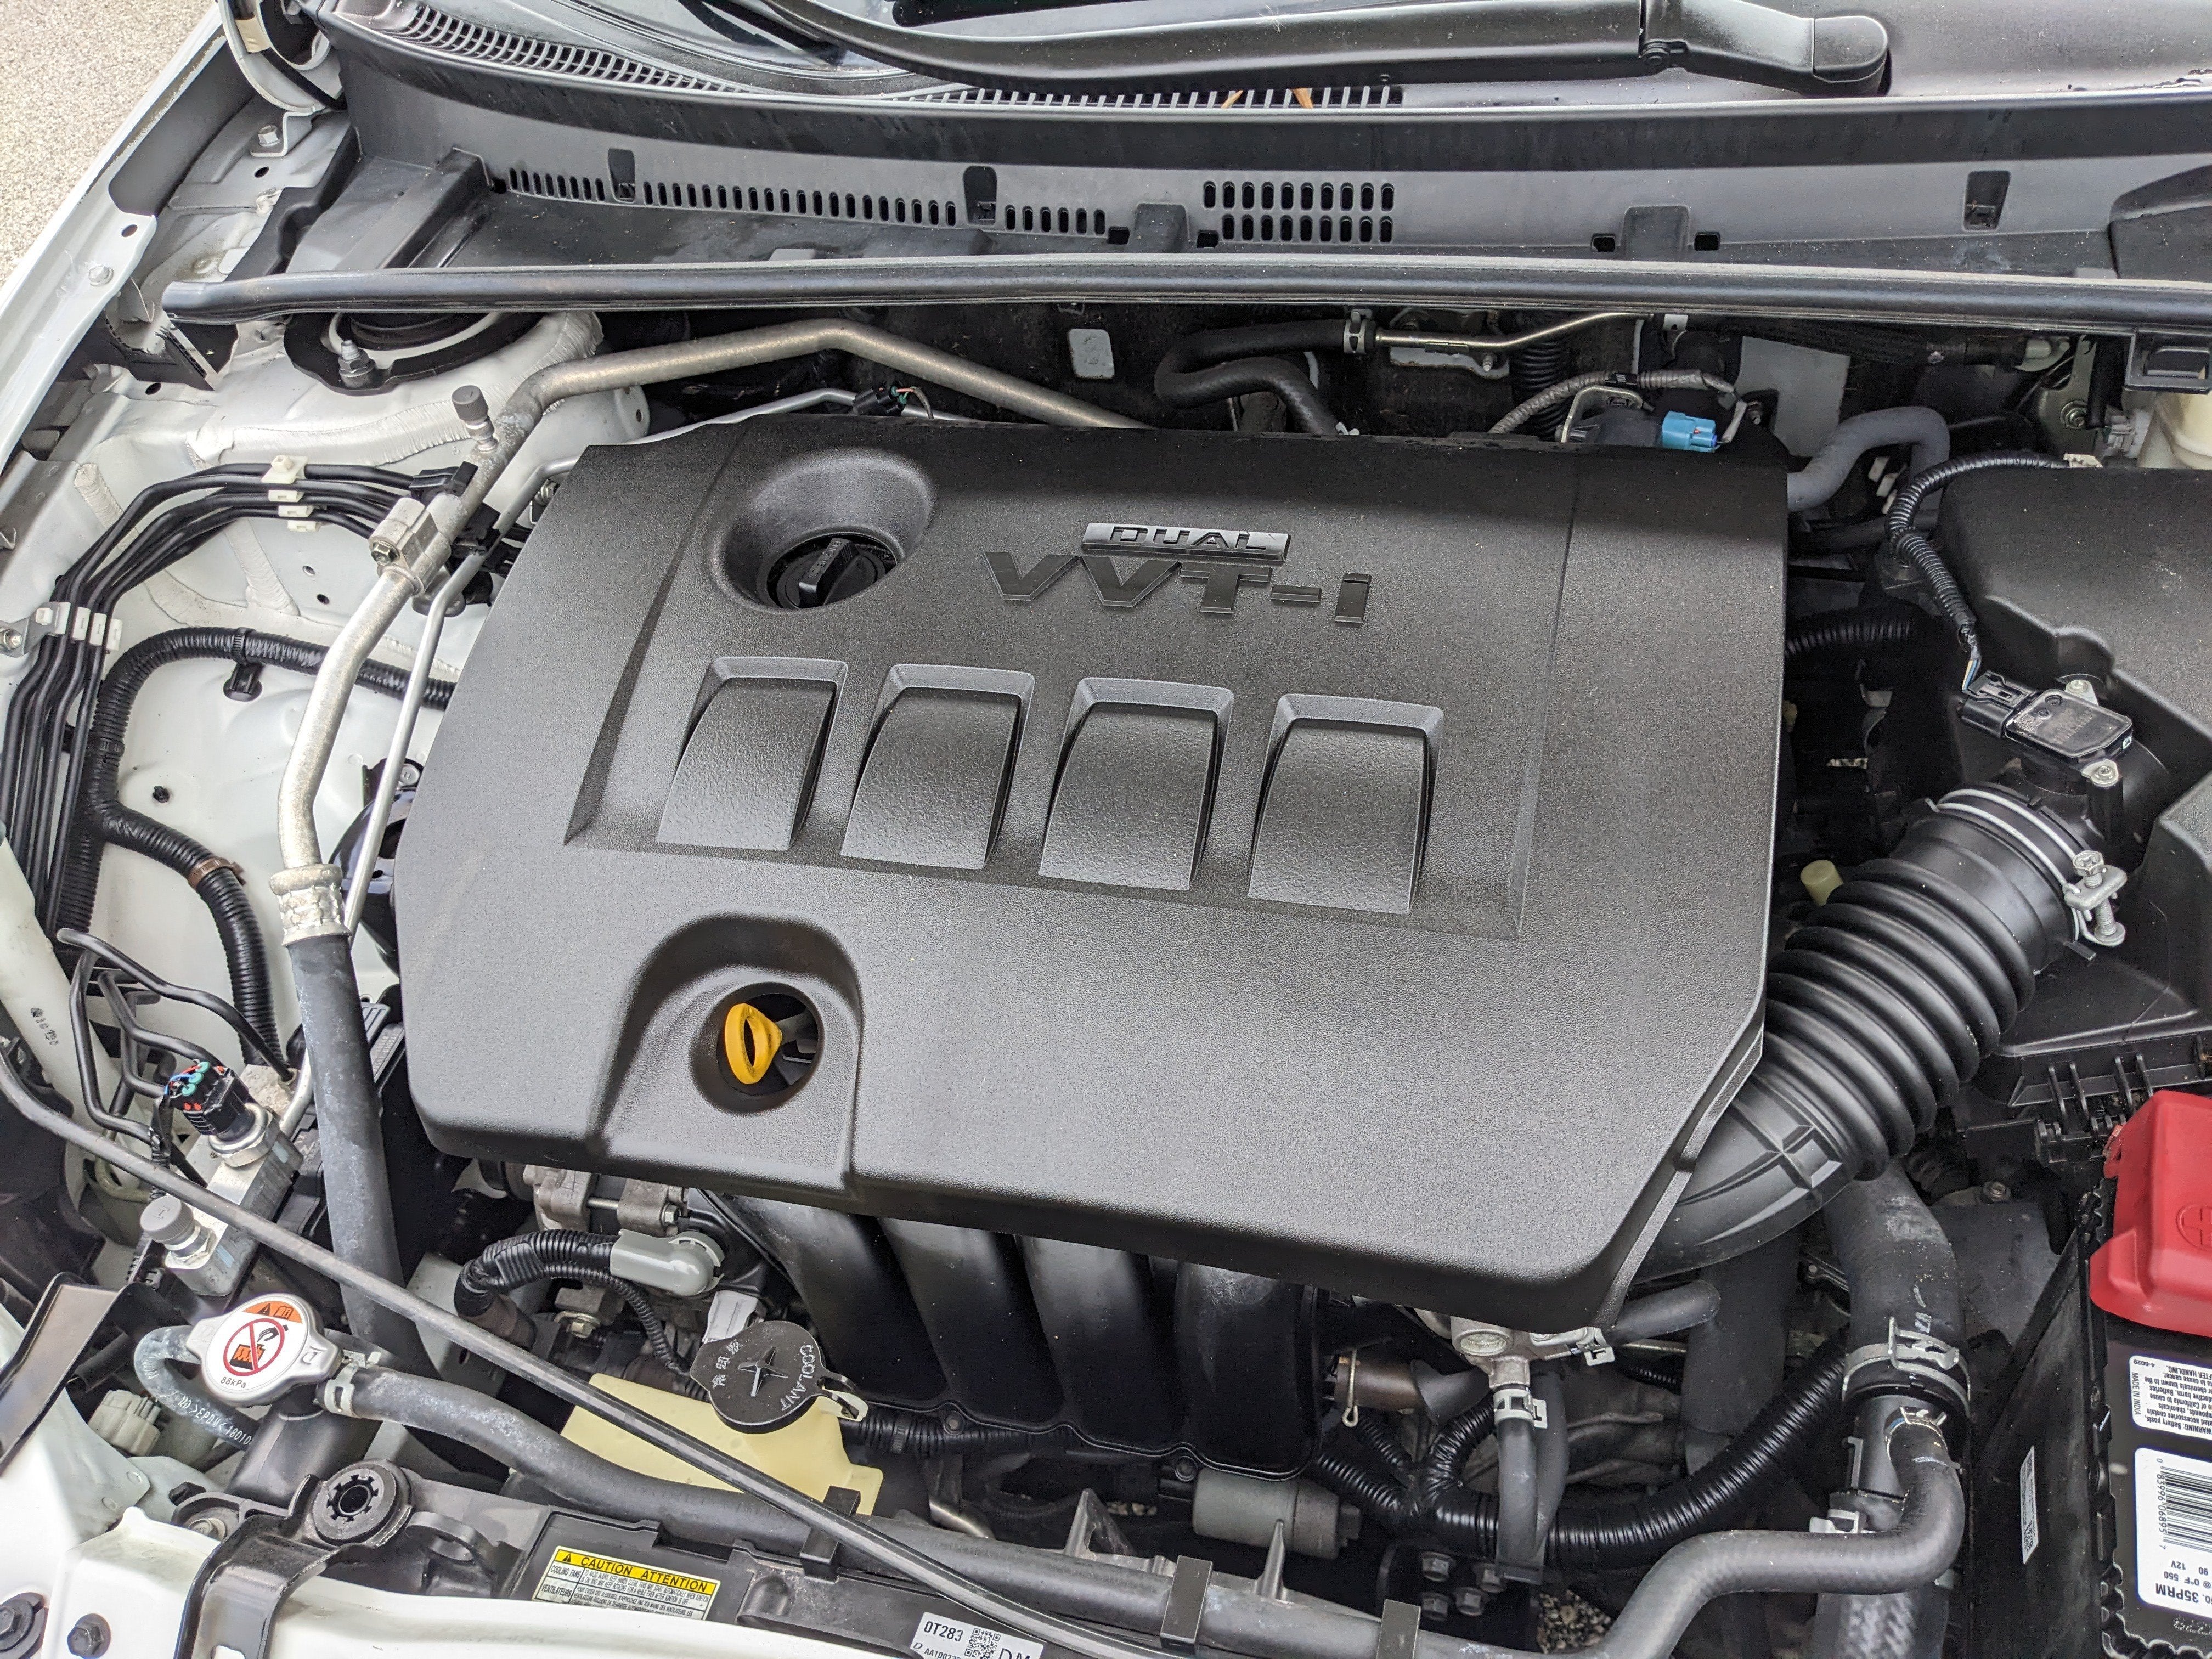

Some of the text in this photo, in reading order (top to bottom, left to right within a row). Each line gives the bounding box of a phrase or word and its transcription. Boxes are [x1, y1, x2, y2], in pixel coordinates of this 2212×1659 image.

[1109, 526, 1268, 551] DUAL
[2166, 1365, 2197, 1377] HANDLING.
[221, 1377, 246, 1388] 88kPa
[781, 1345, 815, 1411] COOLANT
[2161, 1380, 2178, 1389] known
[2180, 1383, 2207, 1394] chemicals
[2149, 1385, 2173, 1396] Batteries
[2175, 1390, 2191, 1399] harm.
[2159, 1403, 2185, 1413] chemicals
[2174, 1398, 2199, 1409] California
[2147, 1408, 2166, 1417] contain
[2168, 1413, 2199, 1423] accessories
[2145, 1415, 2160, 1423] posts,
[2163, 1418, 2181, 1429] Battery
[225, 1426, 252, 1445] 18010
[2157, 1474, 2166, 1501] 83996
[2158, 1505, 2167, 1533] 06895
[550, 1565, 582, 1578] COOLING FANS
[580, 1556, 708, 1592] CAUTION ATTENTION
[2171, 1561, 2208, 1576] 90 12V
[2164, 1571, 2179, 1581] 550
[541, 1583, 573, 1597] VENTILATEURS
[2155, 1583, 2199, 1603] 35PRM
[924, 1621, 964, 1642] 0T283
